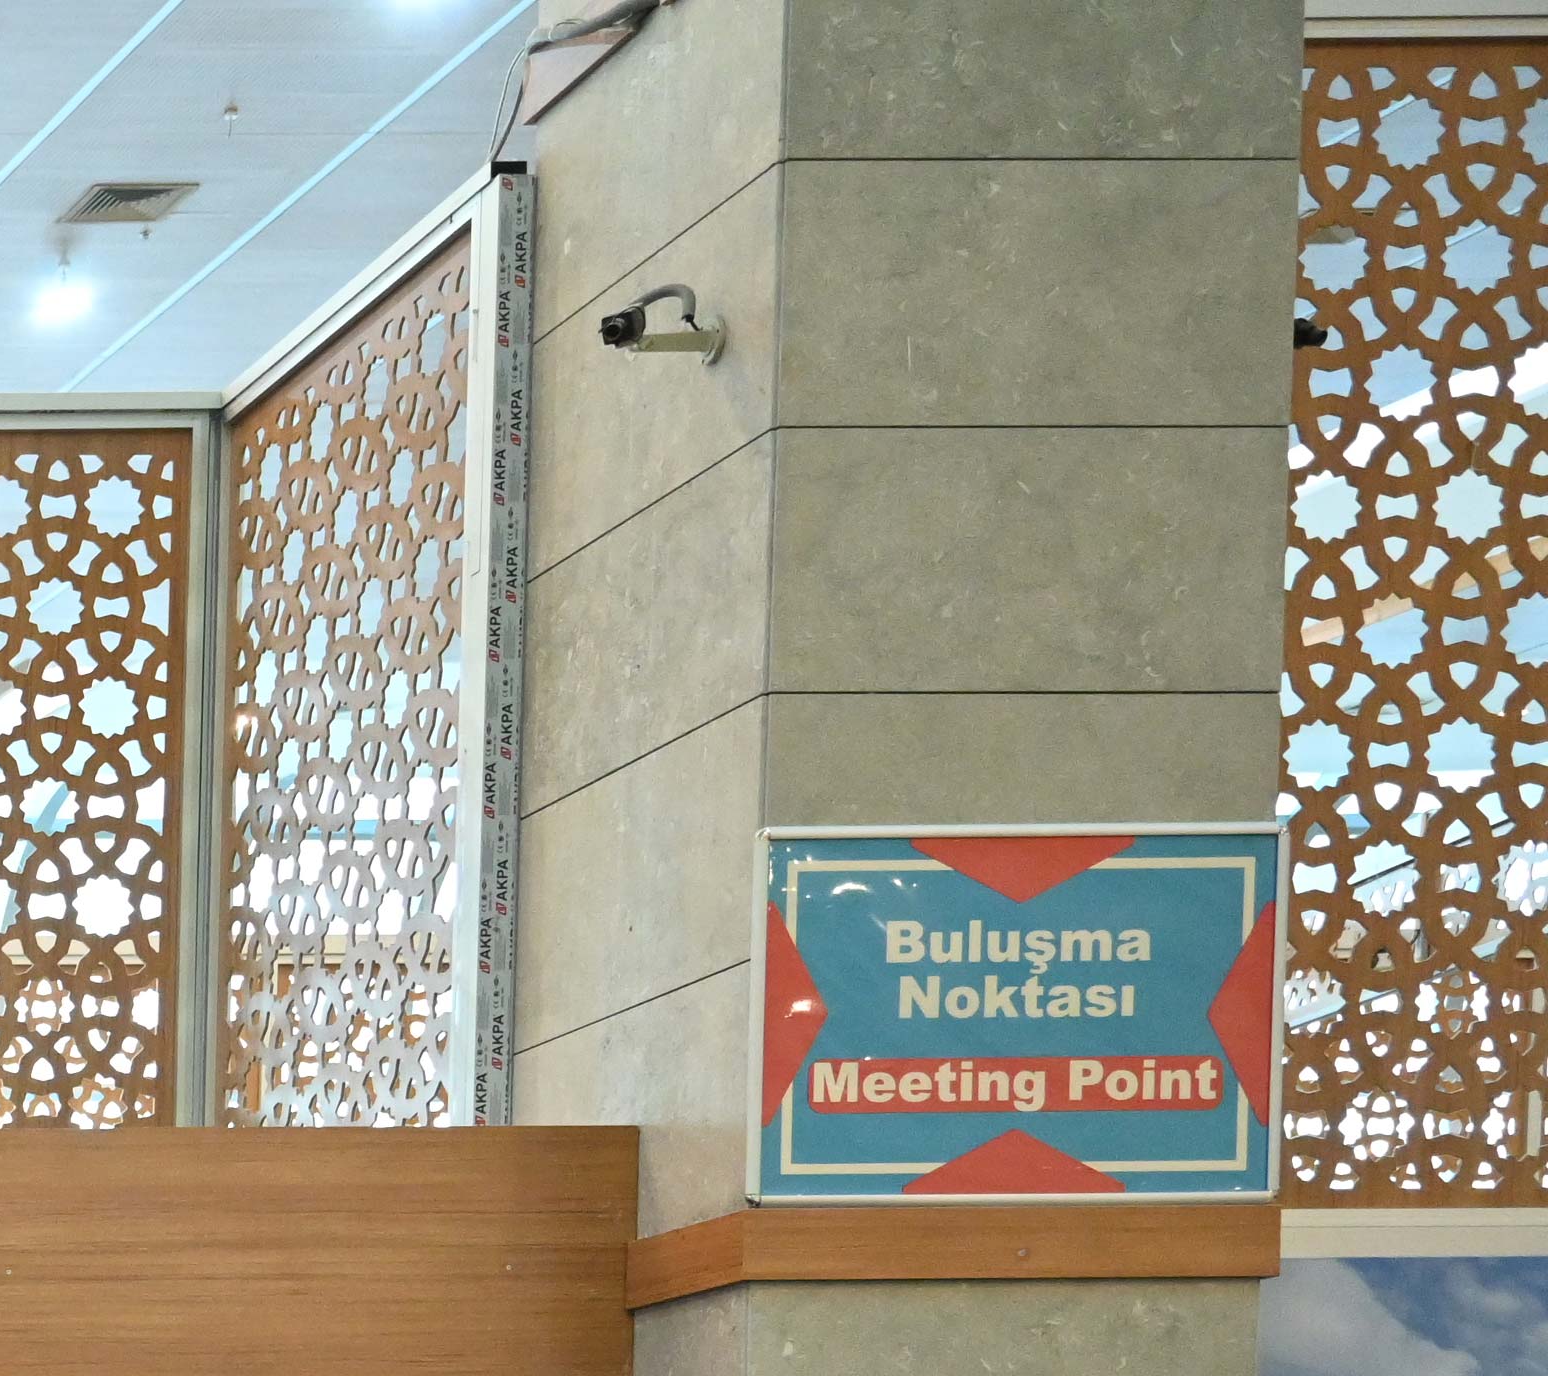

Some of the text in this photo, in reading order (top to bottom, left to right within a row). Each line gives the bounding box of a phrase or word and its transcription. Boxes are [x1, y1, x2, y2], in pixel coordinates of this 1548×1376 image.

[514, 231, 528, 274] AKPA
[499, 290, 511, 334] AKPA
[510, 389, 523, 432] AKPA
[494, 449, 506, 492] AKPA
[506, 546, 518, 589] AKPA
[489, 606, 502, 649] AKPA
[500, 703, 513, 746] AKPA
[484, 762, 496, 805] AKPA
[496, 859, 509, 901] AKPA
[479, 918, 492, 960] AKPA
[885, 919, 1152, 974] Buluşma
[898, 974, 1136, 1019] Noktası
[492, 1014, 504, 1056] AKPA
[475, 1073, 487, 1114] AKPA
[812, 1058, 1218, 1112] Meeting Point
